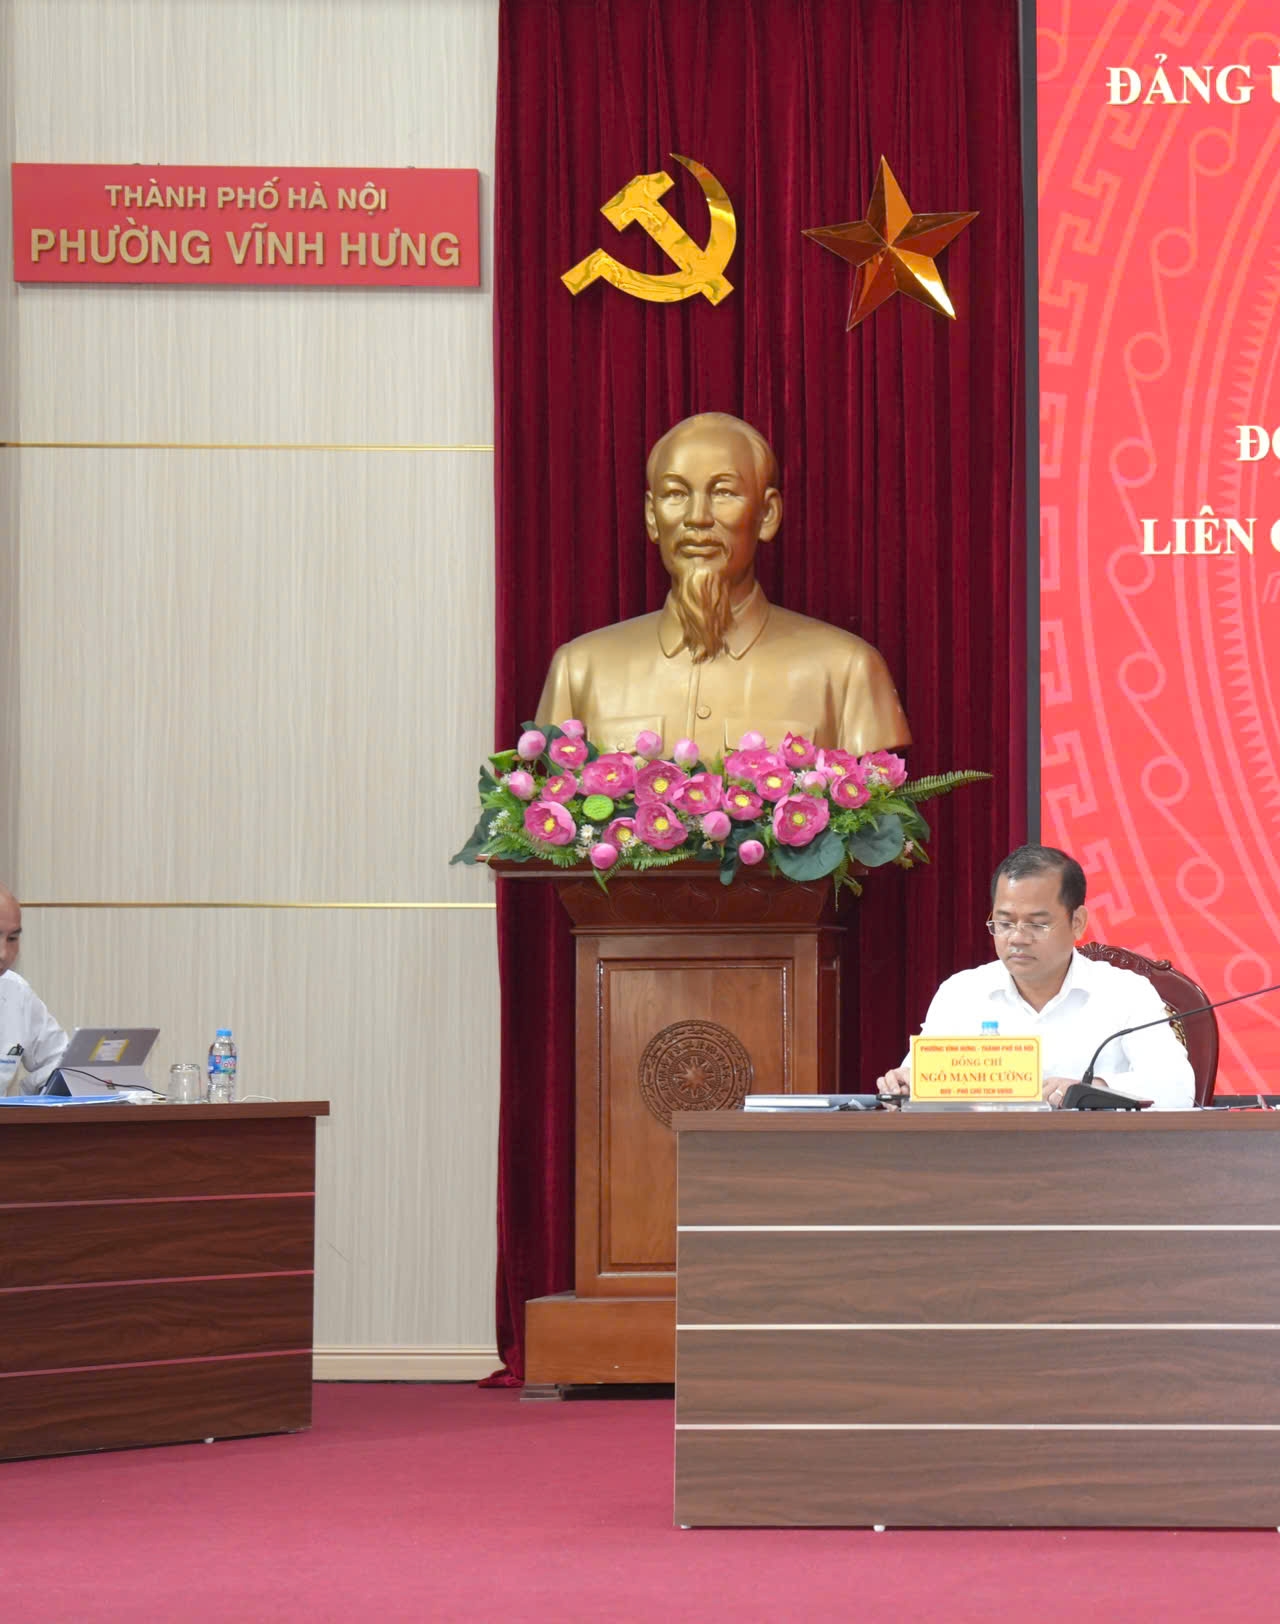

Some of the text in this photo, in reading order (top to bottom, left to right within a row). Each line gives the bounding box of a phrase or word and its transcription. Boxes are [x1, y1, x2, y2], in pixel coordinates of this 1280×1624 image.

[1106, 54, 1254, 104] ĐẢNG
[105, 176, 387, 216] THÀNH PHỐ HÀ NỘI
[31, 217, 460, 266] PHƯỜNG VĨNH HƯNG
[1141, 505, 1257, 555] LIÊN
[920, 1070, 1033, 1085] NGÔ MẠNH CƯỜNG
